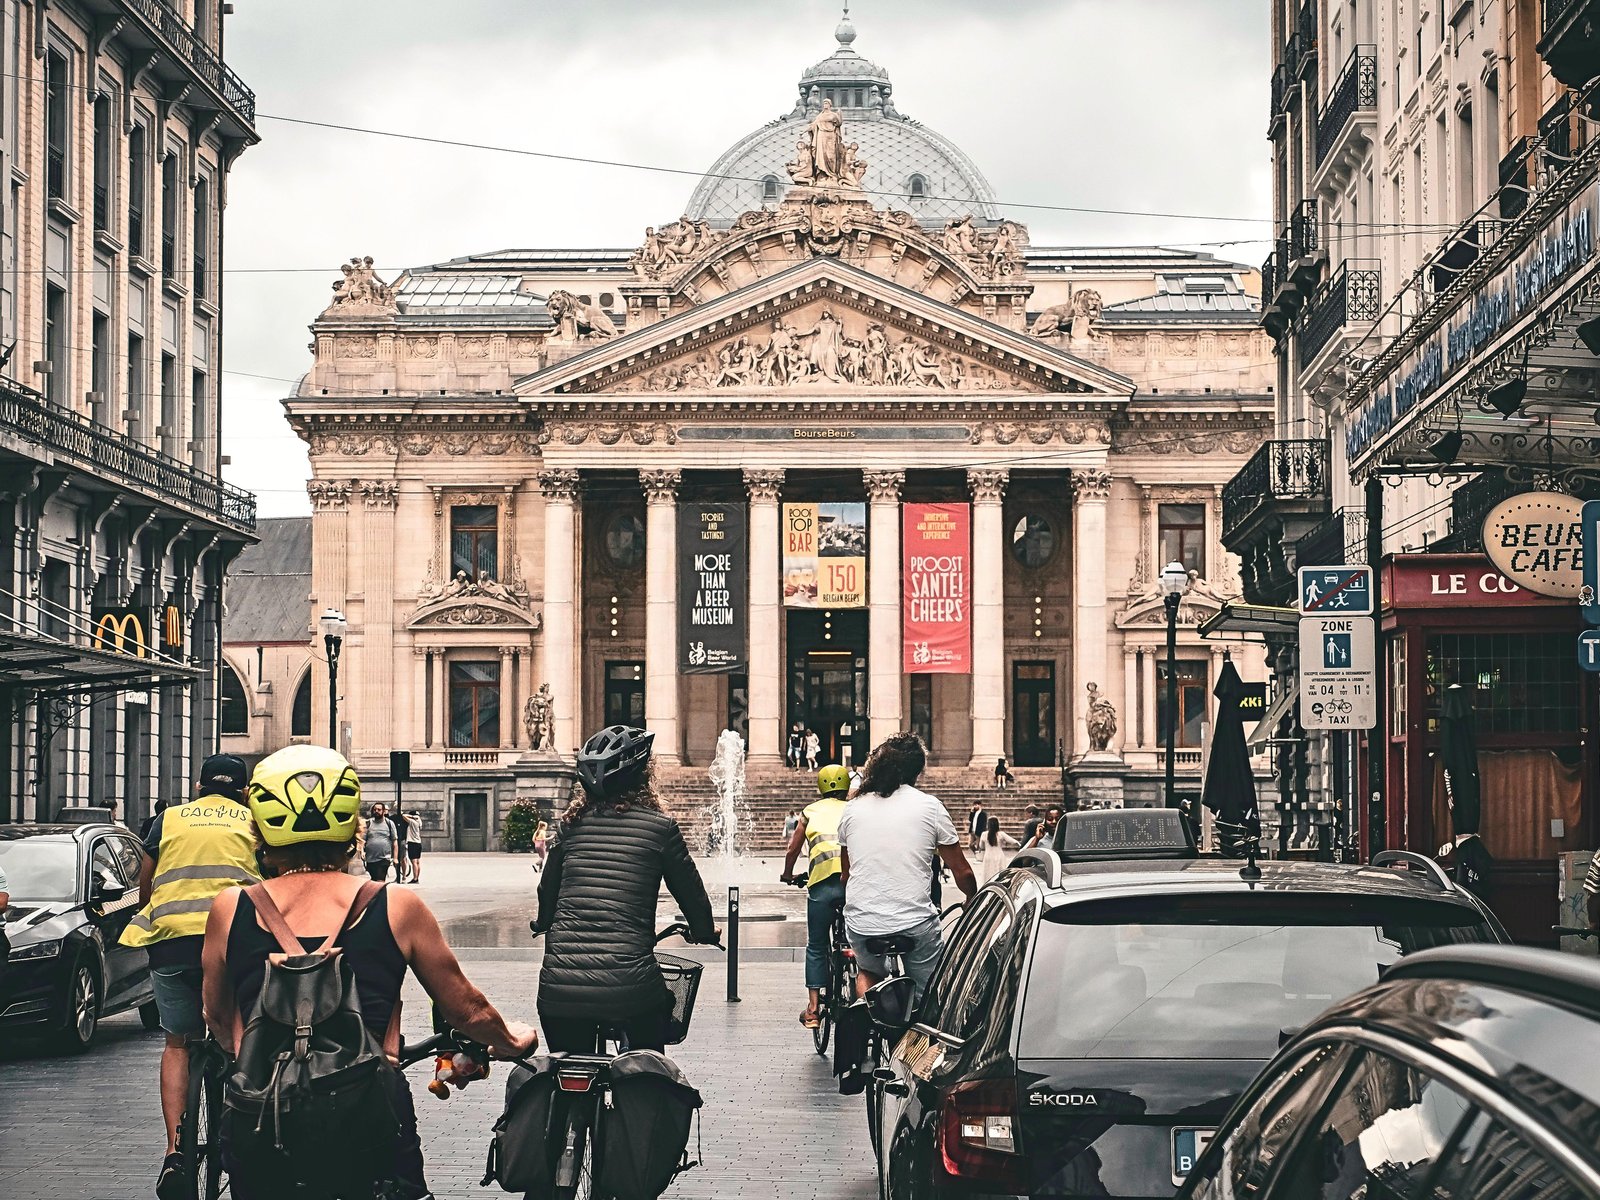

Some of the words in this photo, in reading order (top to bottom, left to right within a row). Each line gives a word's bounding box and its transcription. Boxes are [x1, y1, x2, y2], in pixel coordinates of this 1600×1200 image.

[793, 429, 856, 438] BourseBeurs
[701, 513, 724, 521] STORIES
[789, 508, 812, 518] ROOF
[708, 522, 718, 530] AND
[789, 518, 812, 531] TOP
[789, 533, 812, 552] BAR
[694, 554, 731, 571] MORE
[911, 556, 963, 572] PROOST
[700, 572, 725, 589] THAN
[827, 564, 856, 592] 150
[1431, 574, 1467, 594] LE
[695, 590, 702, 607] A
[705, 590, 730, 607] BEER
[822, 594, 843, 603] BELGIAN
[692, 608, 733, 625] MUSEUM
[911, 598, 963, 622] CHEERS
[1321, 620, 1353, 632] ZONE
[1320, 685, 1334, 696] 04
[1353, 684, 1361, 695] 11
[1328, 716, 1349, 724] TAXI
[1029, 1092, 1098, 1106] ŠKODA
[1181, 1156, 1192, 1171] B
